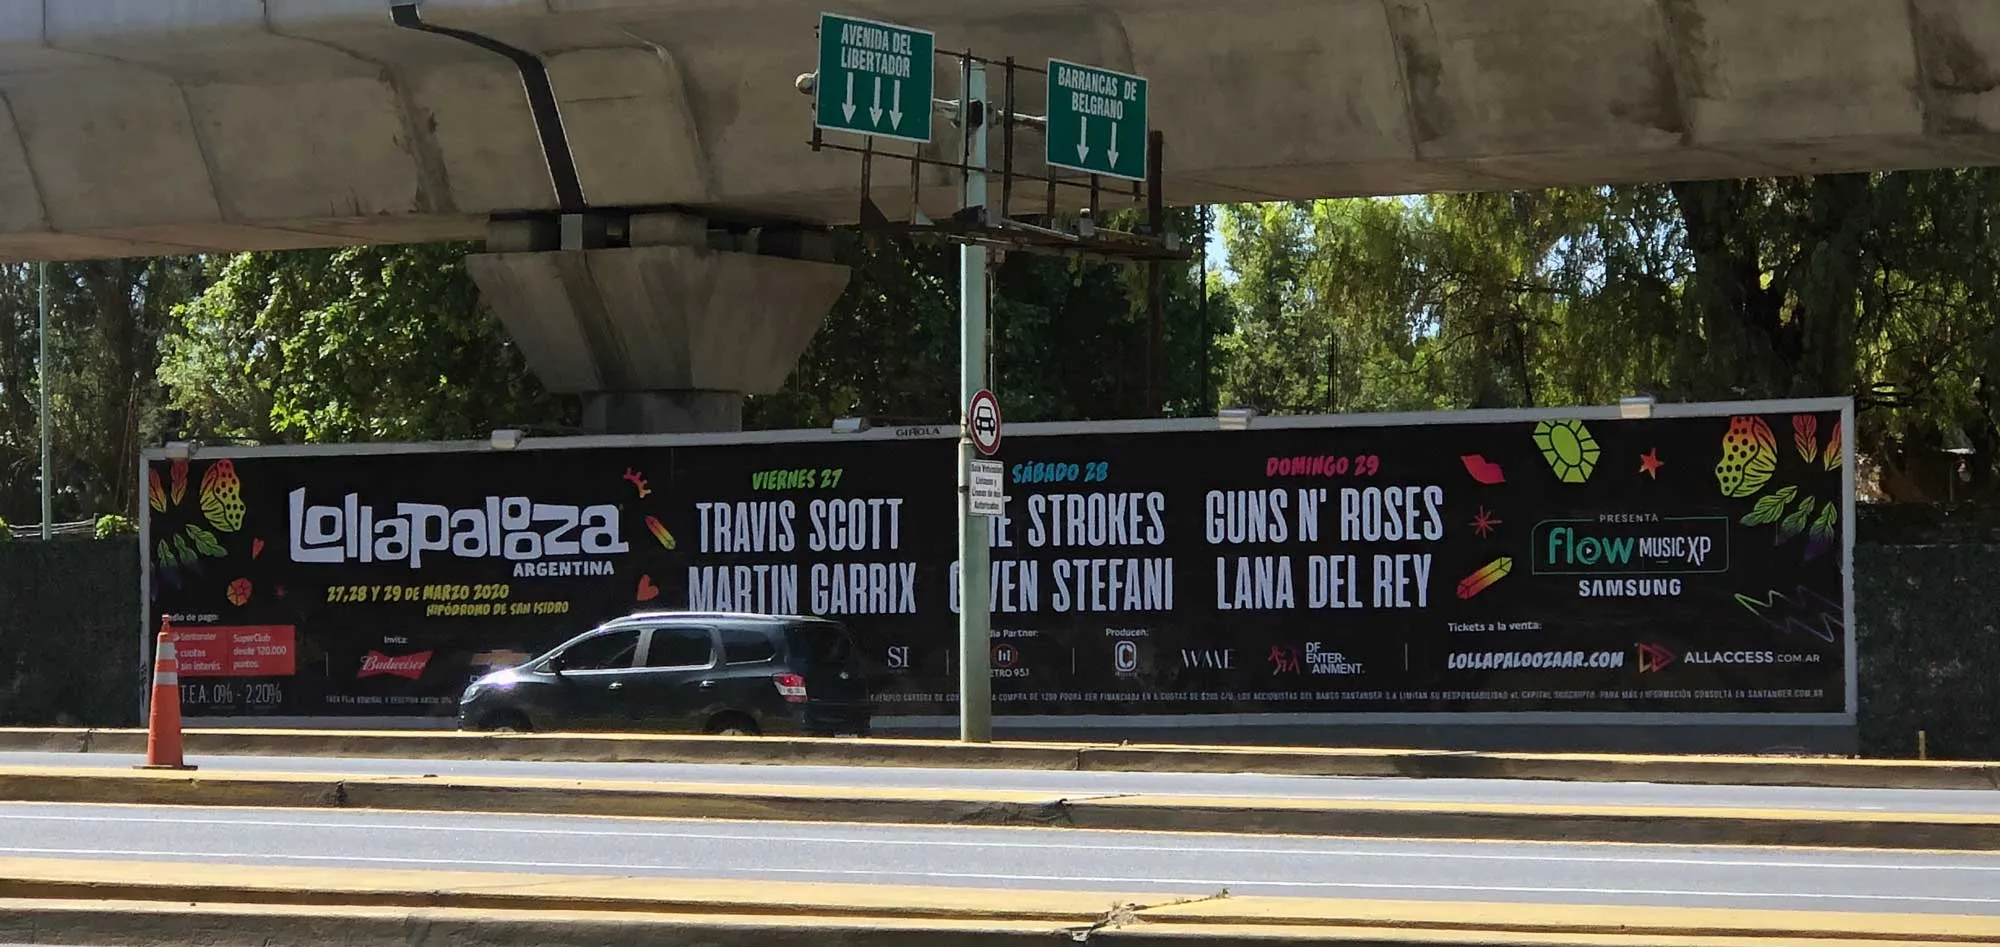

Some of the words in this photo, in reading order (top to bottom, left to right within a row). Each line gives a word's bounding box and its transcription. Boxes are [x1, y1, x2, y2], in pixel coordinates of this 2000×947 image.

[841, 24, 888, 51] AVENIDA
[892, 32, 912, 56] DEL
[841, 46, 910, 78] LIBERTADOR
[1058, 67, 1118, 97] BARRANCAS
[1124, 82, 1136, 100] DE
[1072, 94, 1123, 120] BELGRANO
[896, 427, 940, 437] GIROLA
[1012, 460, 1080, 484] SÁBADO
[1085, 462, 1109, 482] 28
[1266, 456, 1349, 478] DOMINGO
[1354, 455, 1380, 476] 29
[752, 470, 816, 491] VIERNES
[820, 468, 843, 489] 27
[1027, 491, 1166, 547] STROKES
[1205, 488, 1288, 544] GUNS
[1298, 488, 1327, 542] N'
[1340, 485, 1444, 542] ROSES
[1600, 514, 1659, 523] PRESENTA
[289, 487, 630, 568] Lollapalooza
[696, 500, 796, 553] TRAVIS
[809, 498, 903, 552] SCOTT
[1548, 527, 1634, 566] flow
[1640, 537, 1685, 558] MUSIC
[513, 561, 615, 577] ARGENTINA
[688, 563, 798, 616] MARTIN
[810, 562, 917, 616] GARRIX
[1052, 557, 1173, 612] STEFANI
[1216, 556, 1295, 610] LANA
[1308, 554, 1363, 609] DEL
[1373, 554, 1432, 608] REY
[1579, 579, 1682, 597] SAMSUNG
[327, 585, 368, 603] 27,28
[372, 586, 380, 601] Y
[384, 585, 401, 601] 29
[405, 587, 420, 600] DE
[422, 584, 469, 600] MARZO
[474, 584, 510, 600] 2020
[426, 602, 491, 616] HIPÓDROMO
[494, 602, 507, 615] DE
[510, 603, 530, 615] SAN
[534, 601, 569, 614] ISIDRO
[1105, 628, 1150, 637] Producen:
[1448, 622, 1486, 632] Tickets
[1488, 624, 1496, 632] a
[1498, 621, 1507, 632] la
[1508, 622, 1542, 631] venta:
[180, 649, 206, 658] cuotas
[233, 646, 254, 656] desde
[888, 646, 910, 668] SI
[1306, 642, 1321, 652] DF
[180, 662, 192, 670] sin
[360, 655, 427, 671] Budweiser
[1448, 650, 1624, 670] LOLLAPALOOZAAR.COM
[990, 668, 1012, 678] ETRO
[213, 684, 233, 704] 0%
